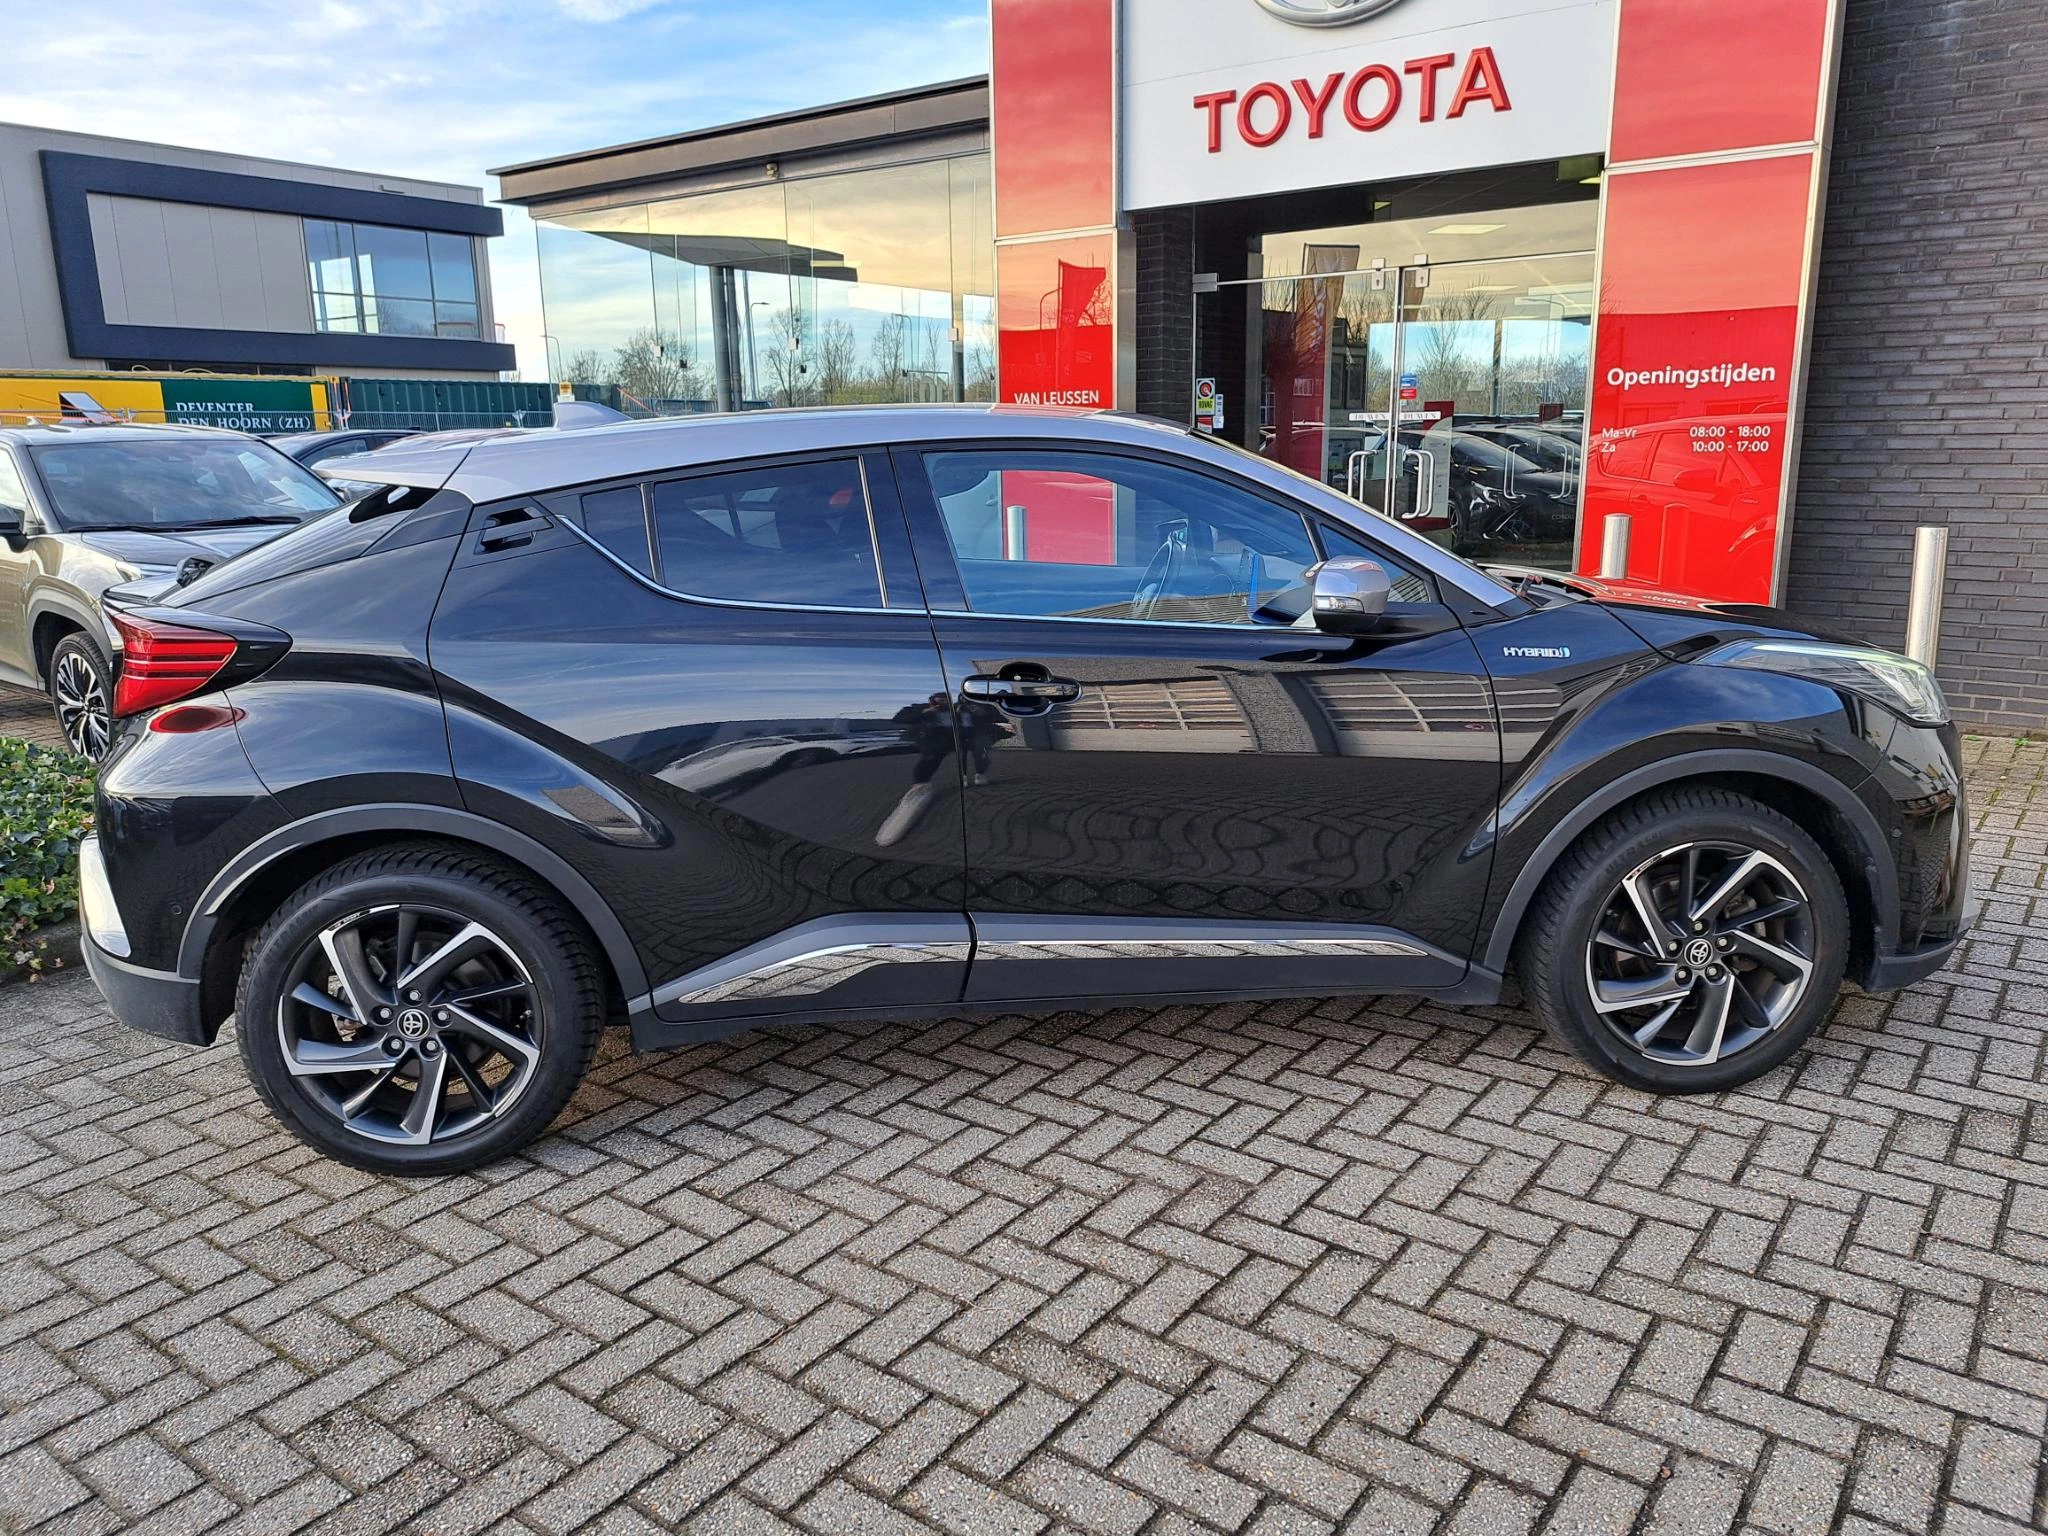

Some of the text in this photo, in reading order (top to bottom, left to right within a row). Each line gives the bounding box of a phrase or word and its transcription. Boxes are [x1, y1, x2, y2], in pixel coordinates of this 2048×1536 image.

[1193, 46, 1511, 153] TOYOTA
[1607, 363, 1775, 390] Openingstijden
[1014, 390, 1100, 405] VAN LEUSSEN
[176, 402, 255, 413] DEVENTER
[218, 417, 272, 429] HOORN
[278, 416, 311, 430] (ZH)
[1602, 428, 1637, 438] Ma-Vr
[1690, 426, 1725, 437] 08:00
[1737, 425, 1771, 437] 18:00
[1601, 441, 1616, 453] Za
[1692, 440, 1725, 452] 10:00
[1736, 440, 1769, 452] 17:00
[1503, 646, 1560, 658] HYBRID
